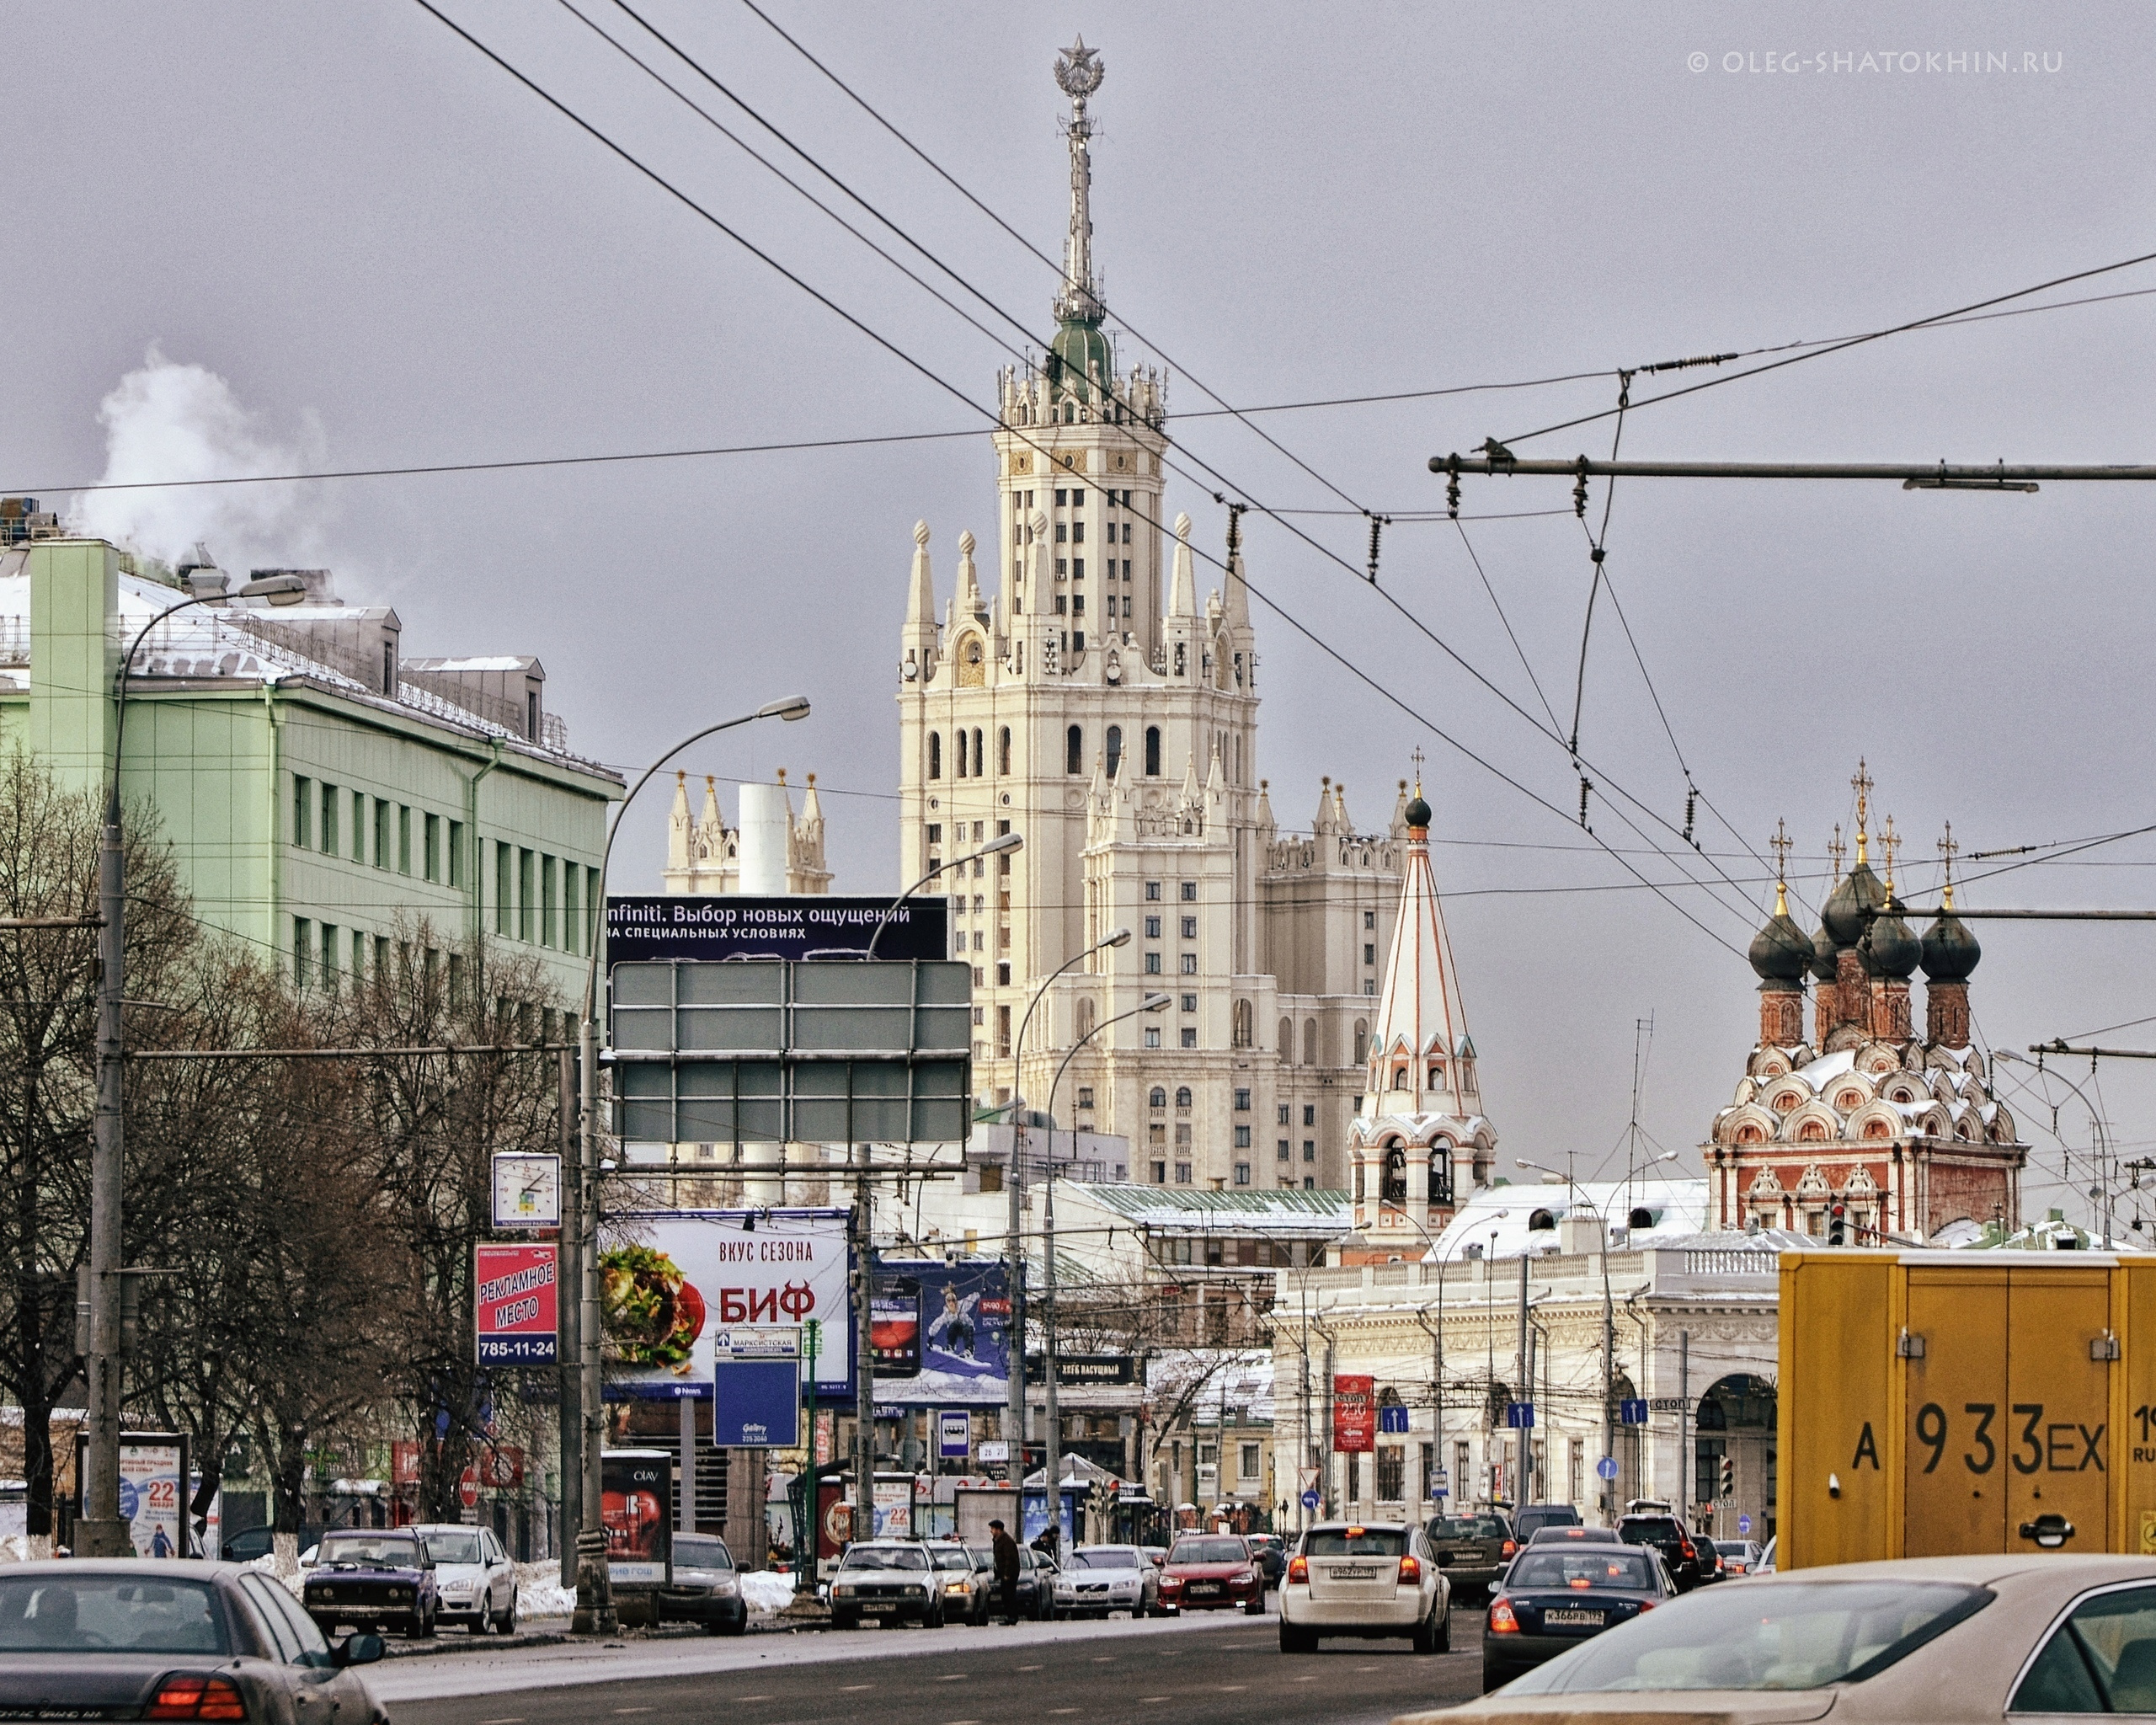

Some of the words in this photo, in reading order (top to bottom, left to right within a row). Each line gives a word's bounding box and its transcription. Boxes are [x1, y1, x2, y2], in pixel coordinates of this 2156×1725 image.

[607, 905, 667, 923] nfiniti.
[674, 904, 737, 927] Выбор
[743, 909, 803, 923] новых
[809, 907, 910, 927] ощущений
[625, 927, 728, 940] СПЕЦИАЛЬНЫХ
[732, 927, 806, 939] УСЛОВИЯХ
[719, 1242, 754, 1262] ВКУС
[761, 1242, 813, 1262] СЕЗОНА
[479, 1261, 554, 1305] РЕКЛАМНОЕ
[720, 1279, 815, 1322] БИФ
[496, 1296, 538, 1329] МЕСТО
[480, 1342, 555, 1357] 785-11-24
[1062, 1364, 1080, 1375] ХЛЕБ
[1081, 1364, 1119, 1375] НАСУЩНЫЙ
[681, 1386, 702, 1395] News
[1341, 1402, 1366, 1418] 250
[1655, 1399, 1685, 1408] СТОП
[742, 1423, 766, 1434] Gallery
[2133, 1404, 2156, 1442] 1
[148, 1480, 174, 1501] 22
[890, 1507, 907, 1521] 22
[632, 1567, 653, 1576] ГОШ
